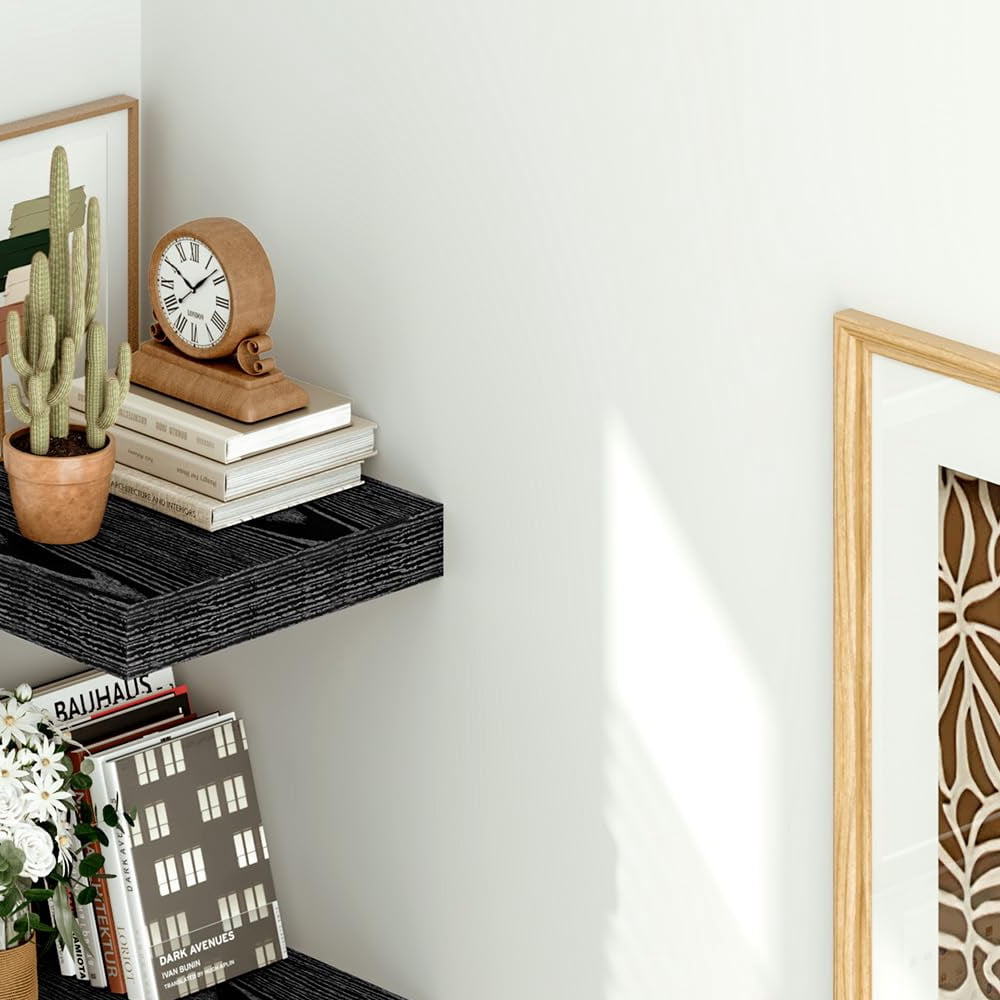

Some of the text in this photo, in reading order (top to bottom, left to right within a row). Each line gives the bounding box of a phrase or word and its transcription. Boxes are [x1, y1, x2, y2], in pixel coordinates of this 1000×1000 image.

[152, 495, 166, 506] AND
[54, 674, 153, 722] BAUHAUS
[122, 859, 133, 892] DARK
[159, 931, 236, 967] DARK AVENUES
[161, 959, 201, 980] IVAN BUNIN
